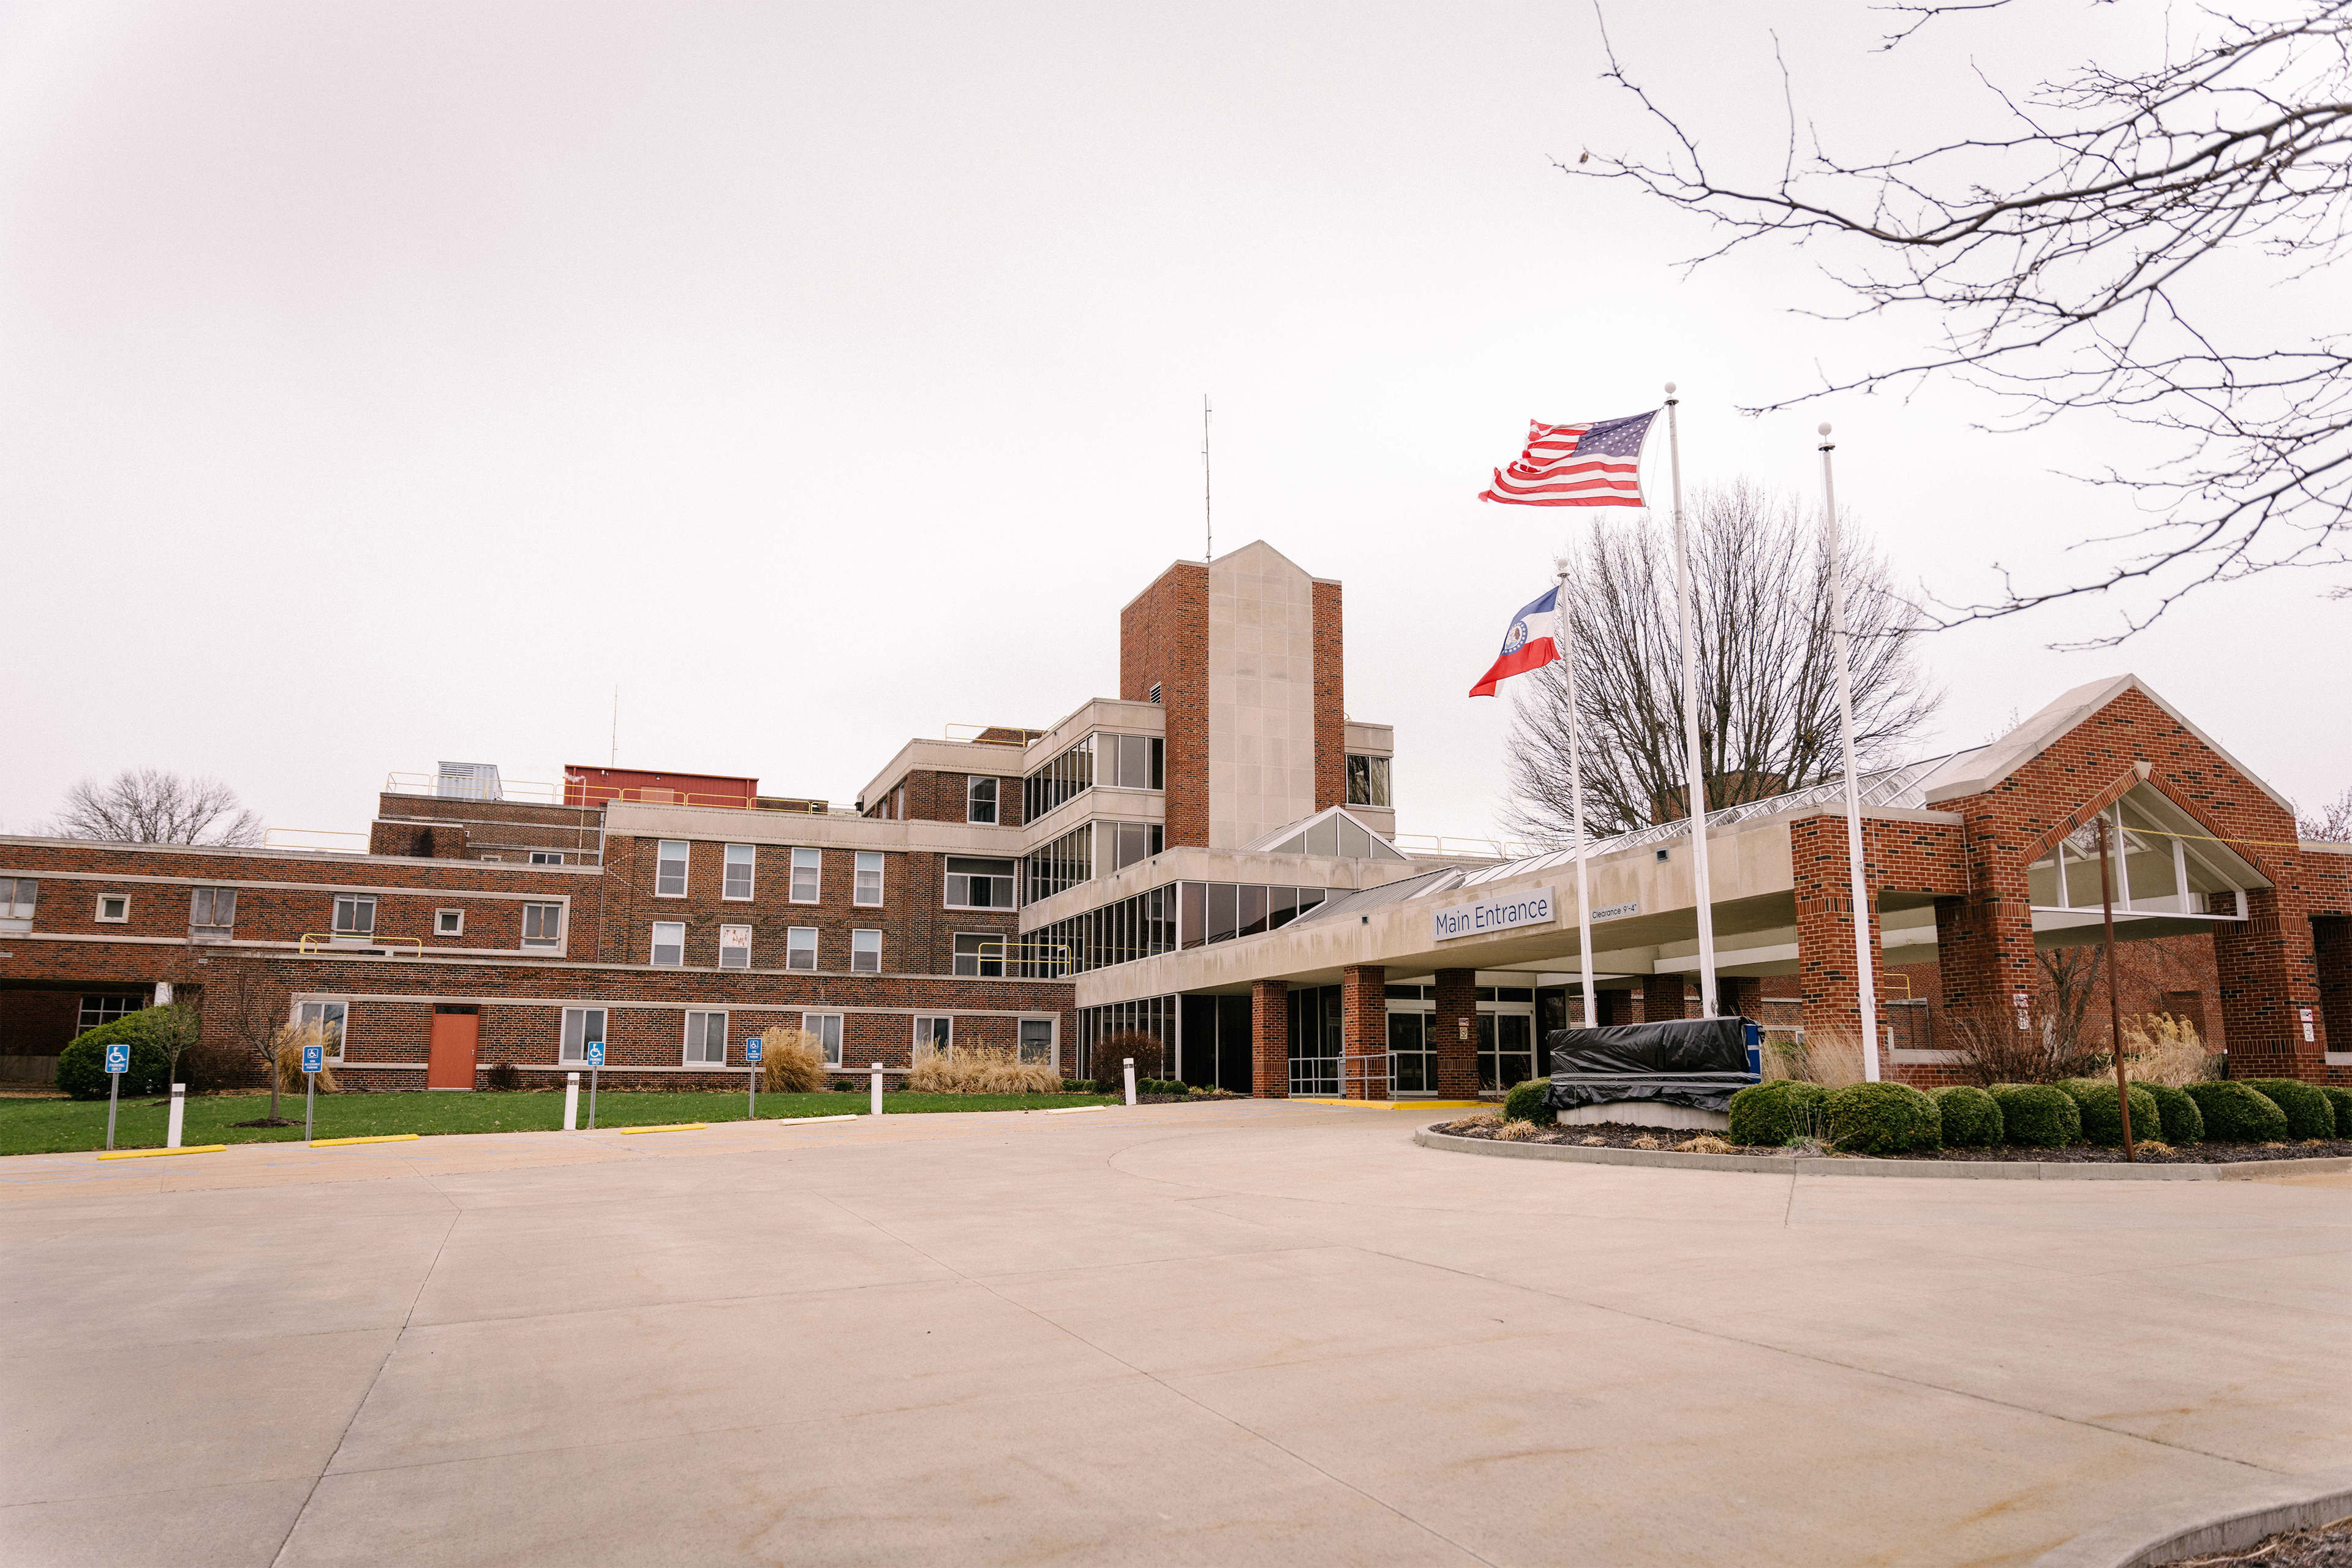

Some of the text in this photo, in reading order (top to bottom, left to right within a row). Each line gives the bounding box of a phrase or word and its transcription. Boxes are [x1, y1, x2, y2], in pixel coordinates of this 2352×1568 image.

[1436, 899, 1547, 935] Main Entrance
[1592, 908, 1621, 918] Clearance
